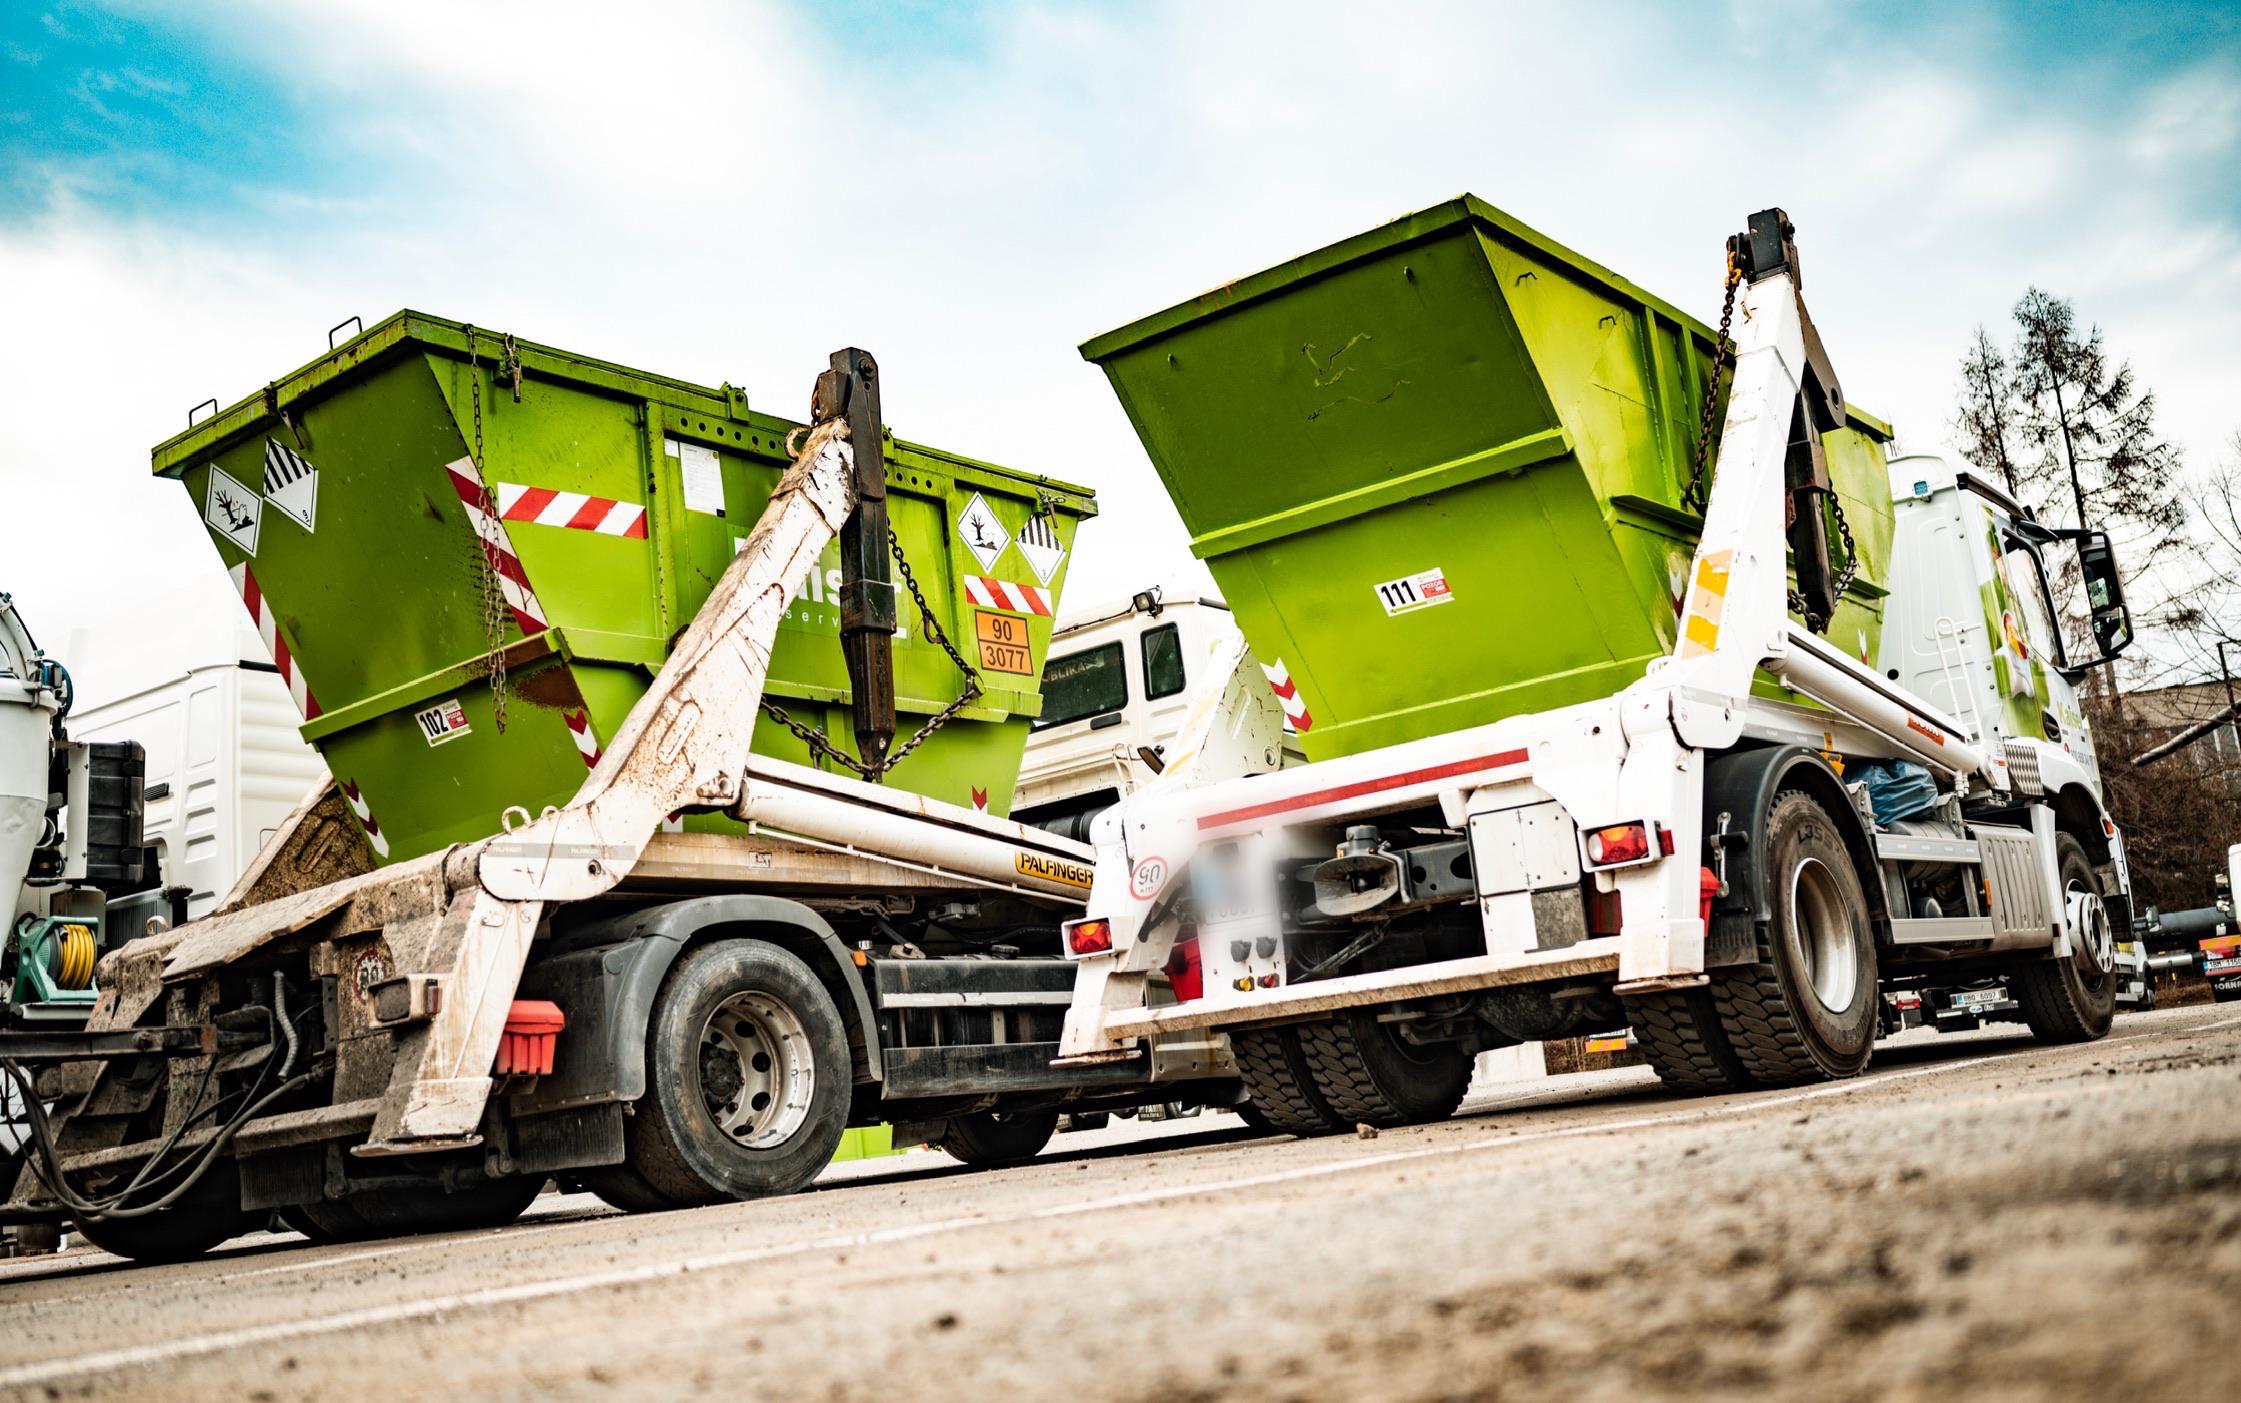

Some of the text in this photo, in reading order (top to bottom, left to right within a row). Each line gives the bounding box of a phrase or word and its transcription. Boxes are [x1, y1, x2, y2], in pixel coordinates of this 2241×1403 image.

[1380, 580, 1417, 607] 111
[785, 608, 840, 627] serv
[992, 618, 1013, 642] 90
[985, 645, 1025, 670] 3077
[419, 708, 449, 737] 102
[1020, 853, 1094, 885] PALFINGER
